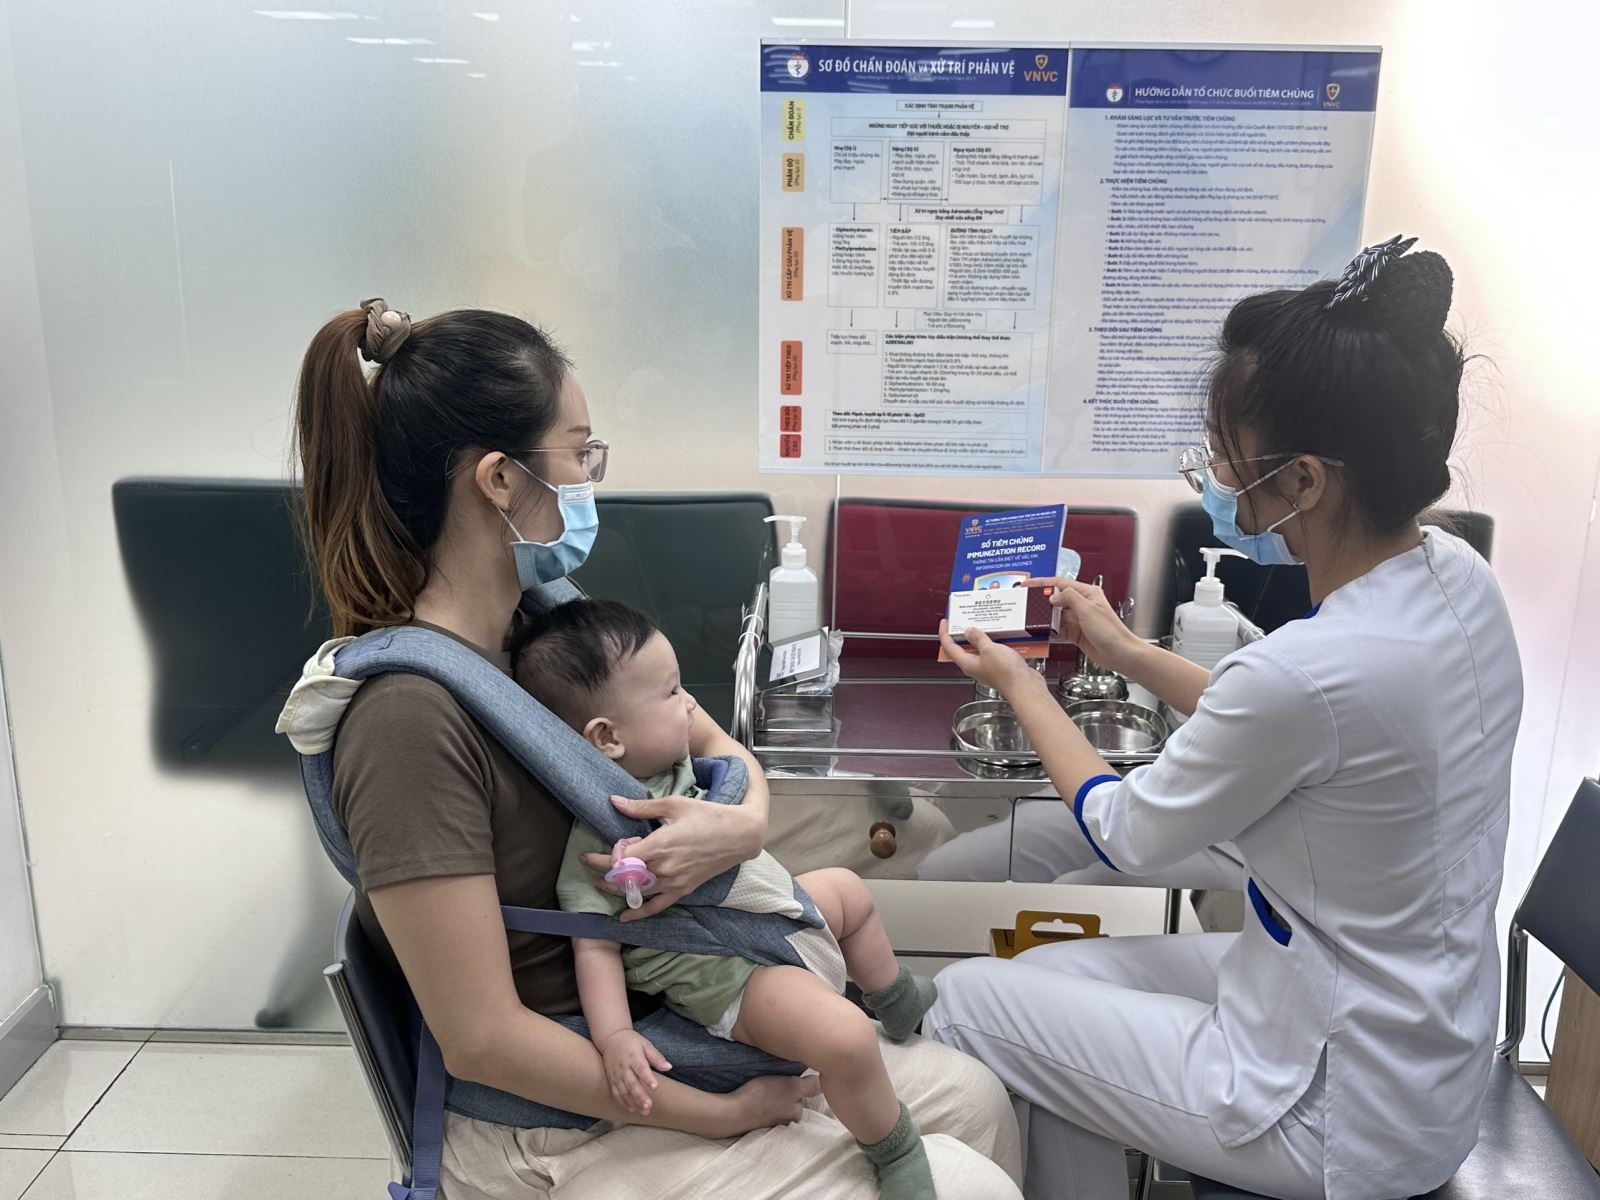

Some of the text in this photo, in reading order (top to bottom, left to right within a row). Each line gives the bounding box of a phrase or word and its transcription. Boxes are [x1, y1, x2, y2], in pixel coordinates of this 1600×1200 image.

[818, 58, 833, 72] SƠ
[885, 58, 916, 73] ĐOÁN
[930, 58, 946, 74] XỬ
[947, 58, 966, 74] TRÍ
[968, 58, 998, 74] PHẢN
[1002, 60, 1015, 78] VỆ
[1024, 70, 1058, 82] VNVC
[1135, 87, 1170, 97] HƯỚNG
[1206, 87, 1232, 97] CHỨC
[1258, 88, 1280, 98] TIÊM
[1281, 88, 1314, 99] CHỦNG
[992, 537, 1008, 547] TIÊM
[1010, 536, 1034, 545] CHỦNG
[967, 544, 1046, 559] IMMUNIZATION RECORD
[976, 562, 1003, 570] INFORMATION
